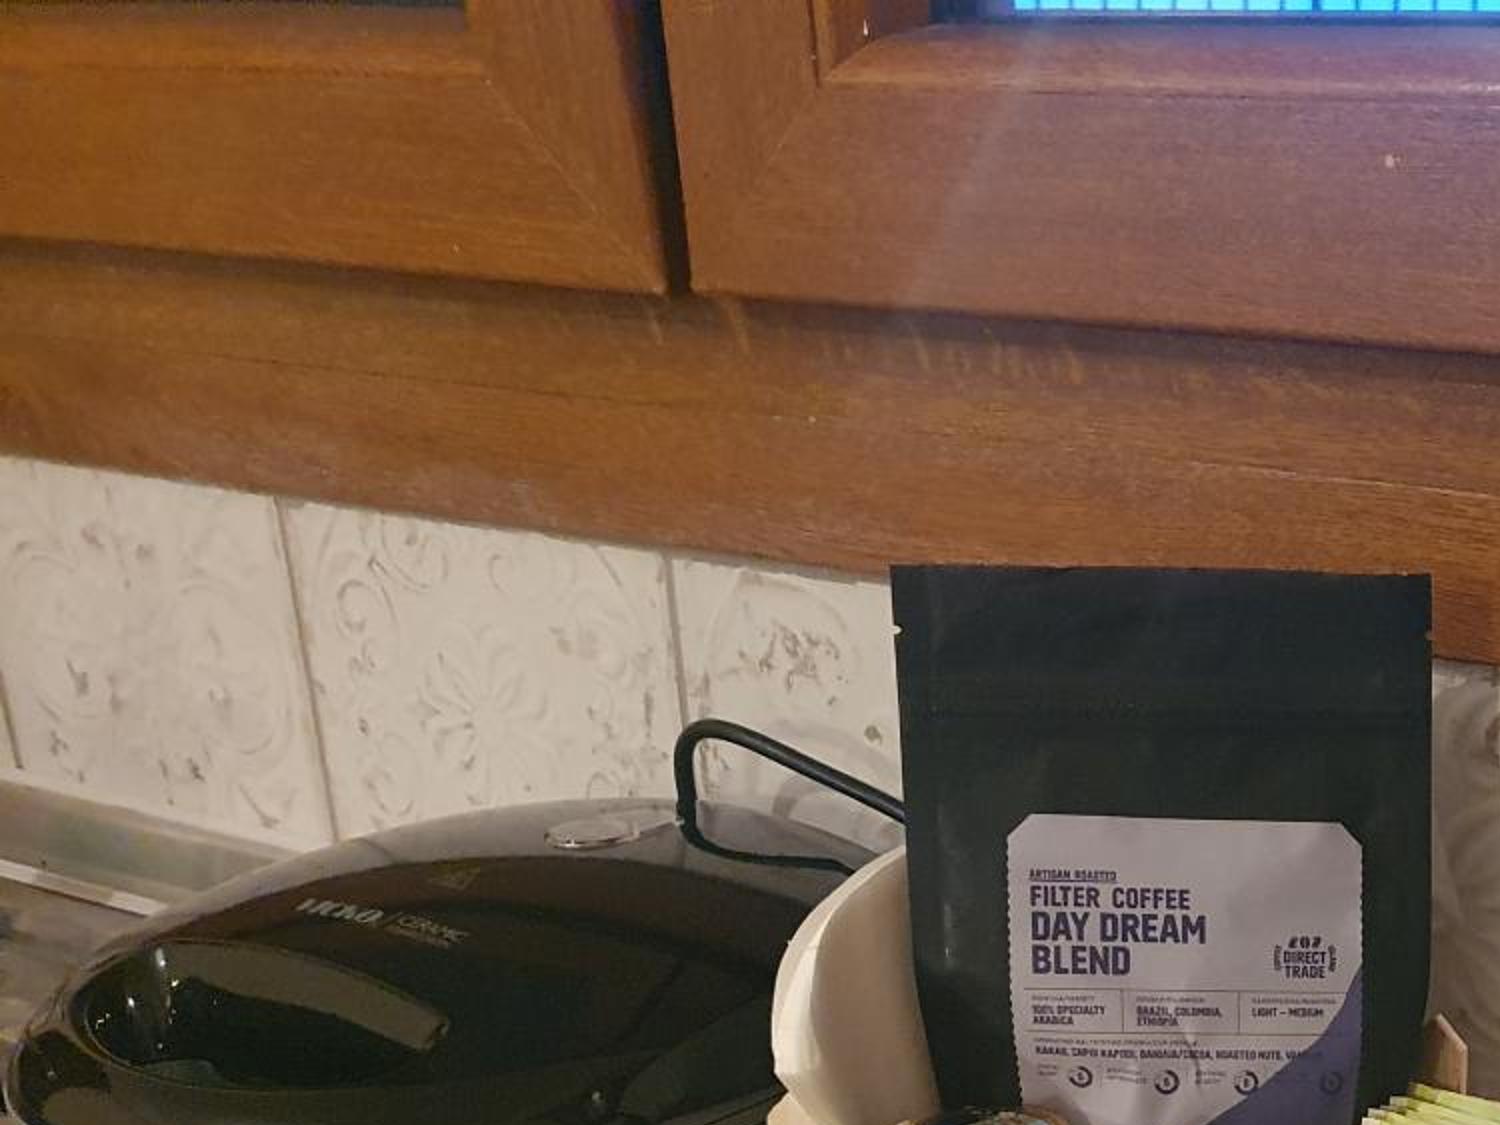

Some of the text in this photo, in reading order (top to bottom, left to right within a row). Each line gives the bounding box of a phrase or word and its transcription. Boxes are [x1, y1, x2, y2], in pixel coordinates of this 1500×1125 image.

[1029, 869, 1071, 881] ARTISAN
[1029, 885, 1191, 910] FILTER COFFEE
[1031, 911, 1207, 945] DAY DREAM
[1031, 945, 1131, 975] BLEND
[1283, 951, 1327, 965] DIRECT
[1285, 965, 1326, 979] TRADE
[1251, 1007, 1277, 1018] LIGHT
